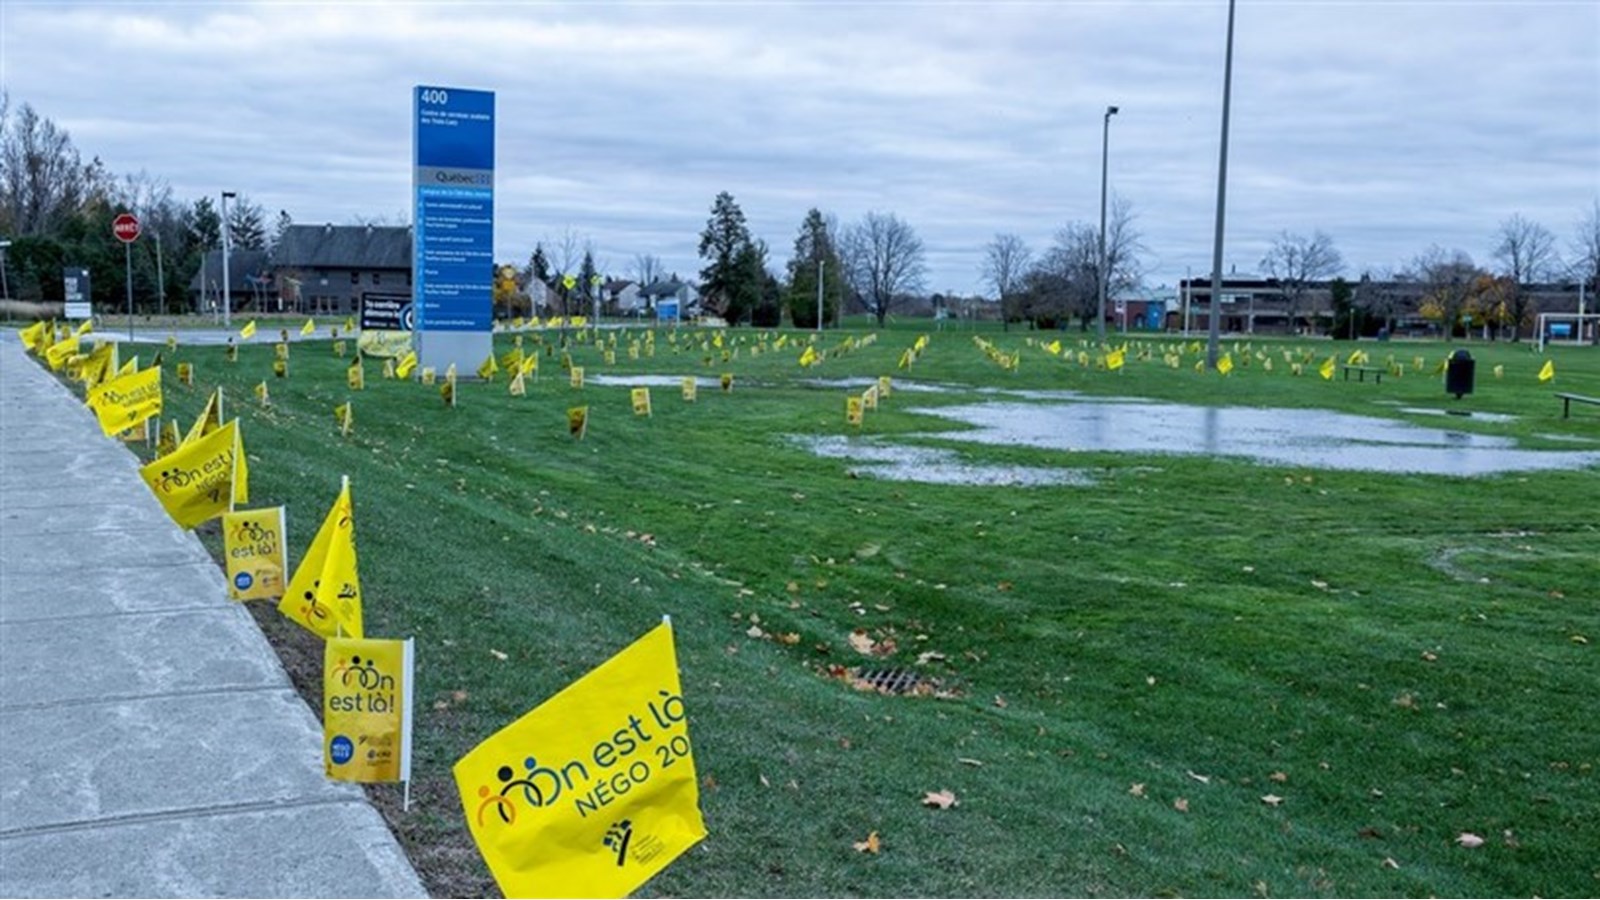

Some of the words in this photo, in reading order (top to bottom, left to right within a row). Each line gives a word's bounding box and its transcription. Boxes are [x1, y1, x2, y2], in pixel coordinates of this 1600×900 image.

[421, 89, 448, 105] 400
[435, 171, 474, 184] Québec
[203, 453, 228, 474] est
[231, 543, 255, 559] est
[257, 541, 277, 556] là!
[329, 693, 362, 712] est
[368, 692, 394, 713] là!
[593, 714, 653, 768] est
[574, 761, 650, 818] NÉGO
